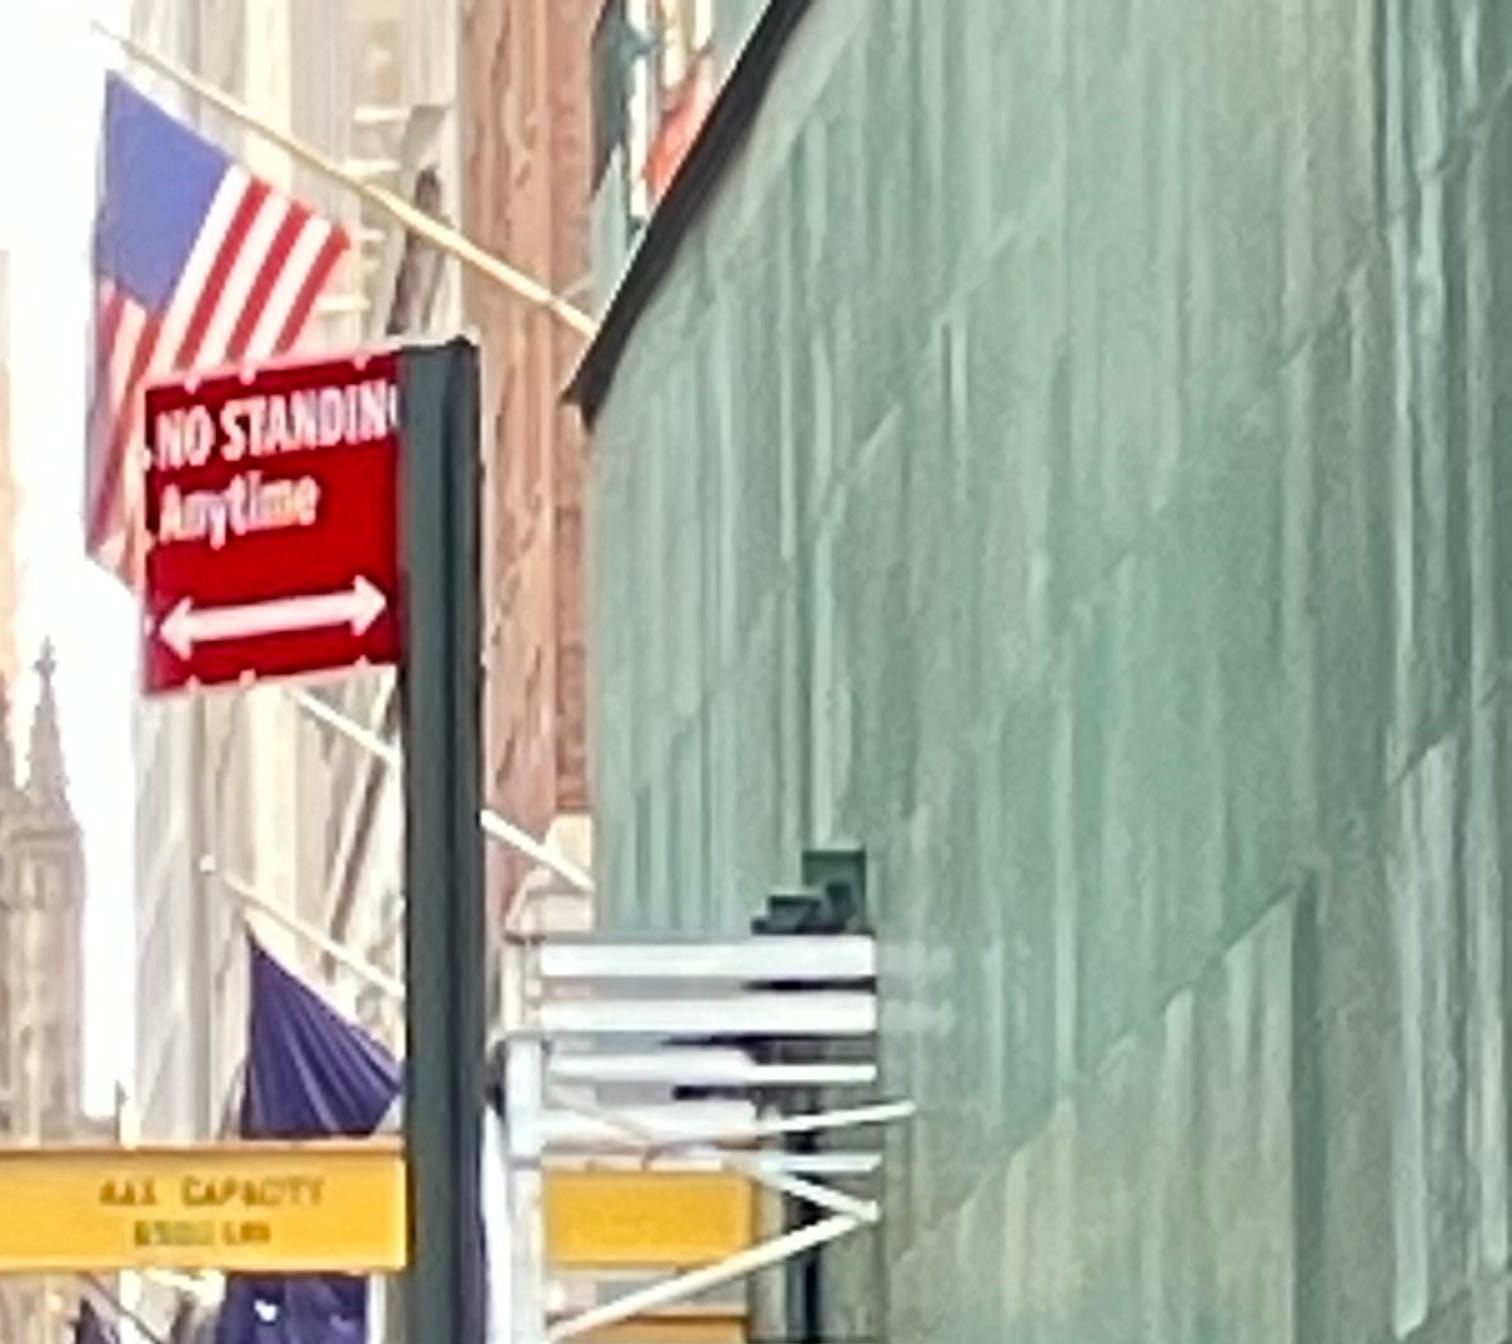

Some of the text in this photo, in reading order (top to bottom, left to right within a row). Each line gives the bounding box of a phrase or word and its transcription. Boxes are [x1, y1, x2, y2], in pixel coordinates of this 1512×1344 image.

[155, 404, 216, 471] NO
[158, 469, 321, 551] Anytime
[180, 1174, 326, 1208] CAPACITY
